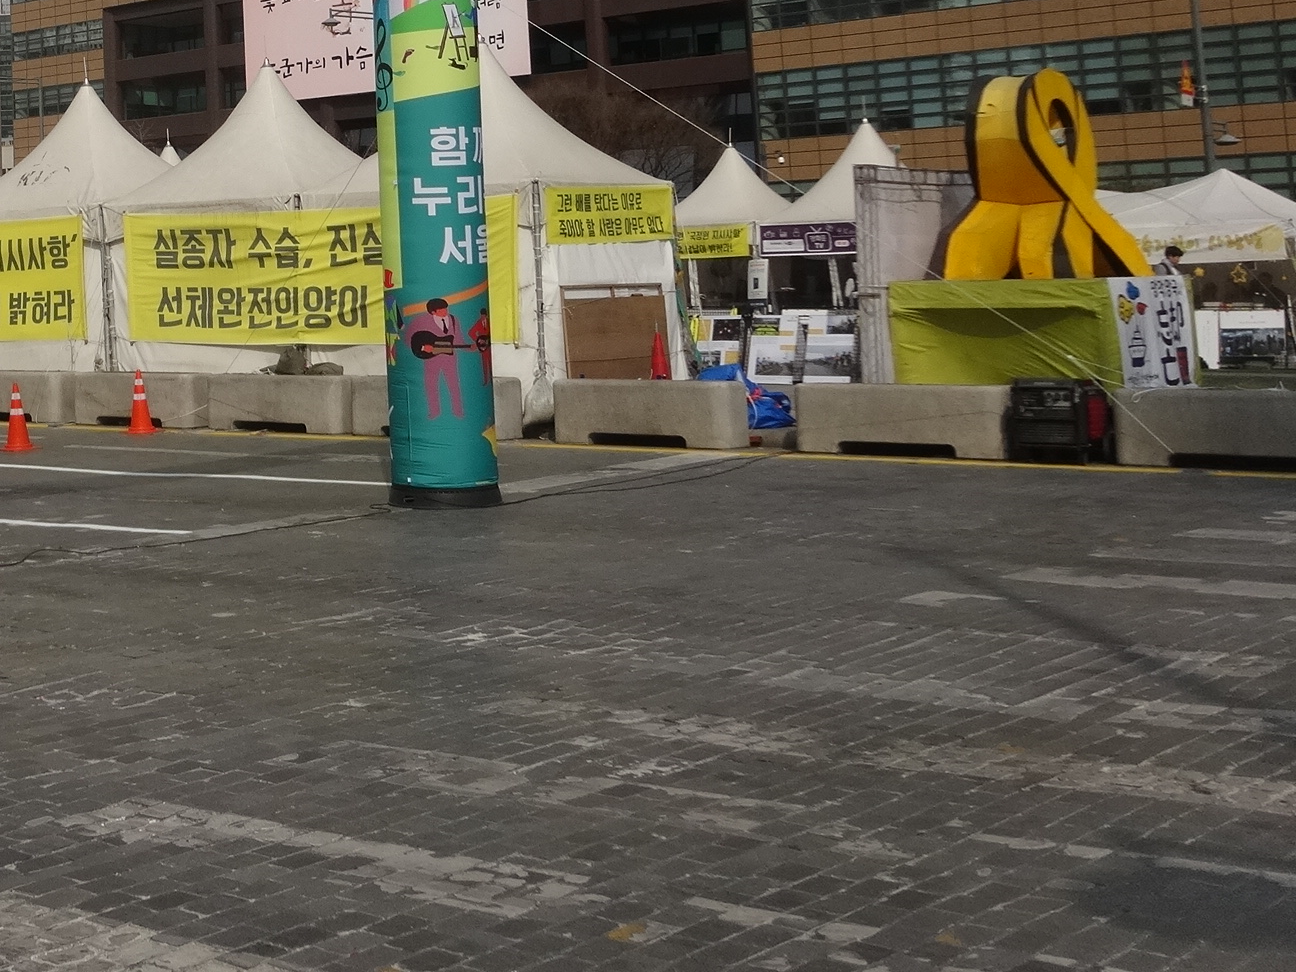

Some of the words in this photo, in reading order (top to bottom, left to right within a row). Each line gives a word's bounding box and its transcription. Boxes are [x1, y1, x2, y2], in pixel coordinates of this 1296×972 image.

[269, 56, 325, 79] 군가의
[332, 46, 373, 71] 가슴
[557, 193, 572, 212] 그런
[594, 193, 618, 212] 탔다는
[620, 192, 643, 211] 이유로
[559, 218, 584, 238] 죽어야
[586, 218, 596, 237] 할
[599, 217, 623, 236] 사람은
[624, 216, 646, 235] 아무도
[646, 215, 664, 234] 없다
[153, 228, 236, 269] 실종자
[247, 226, 313, 269] 수습,
[9, 289, 75, 326] 밝혀라
